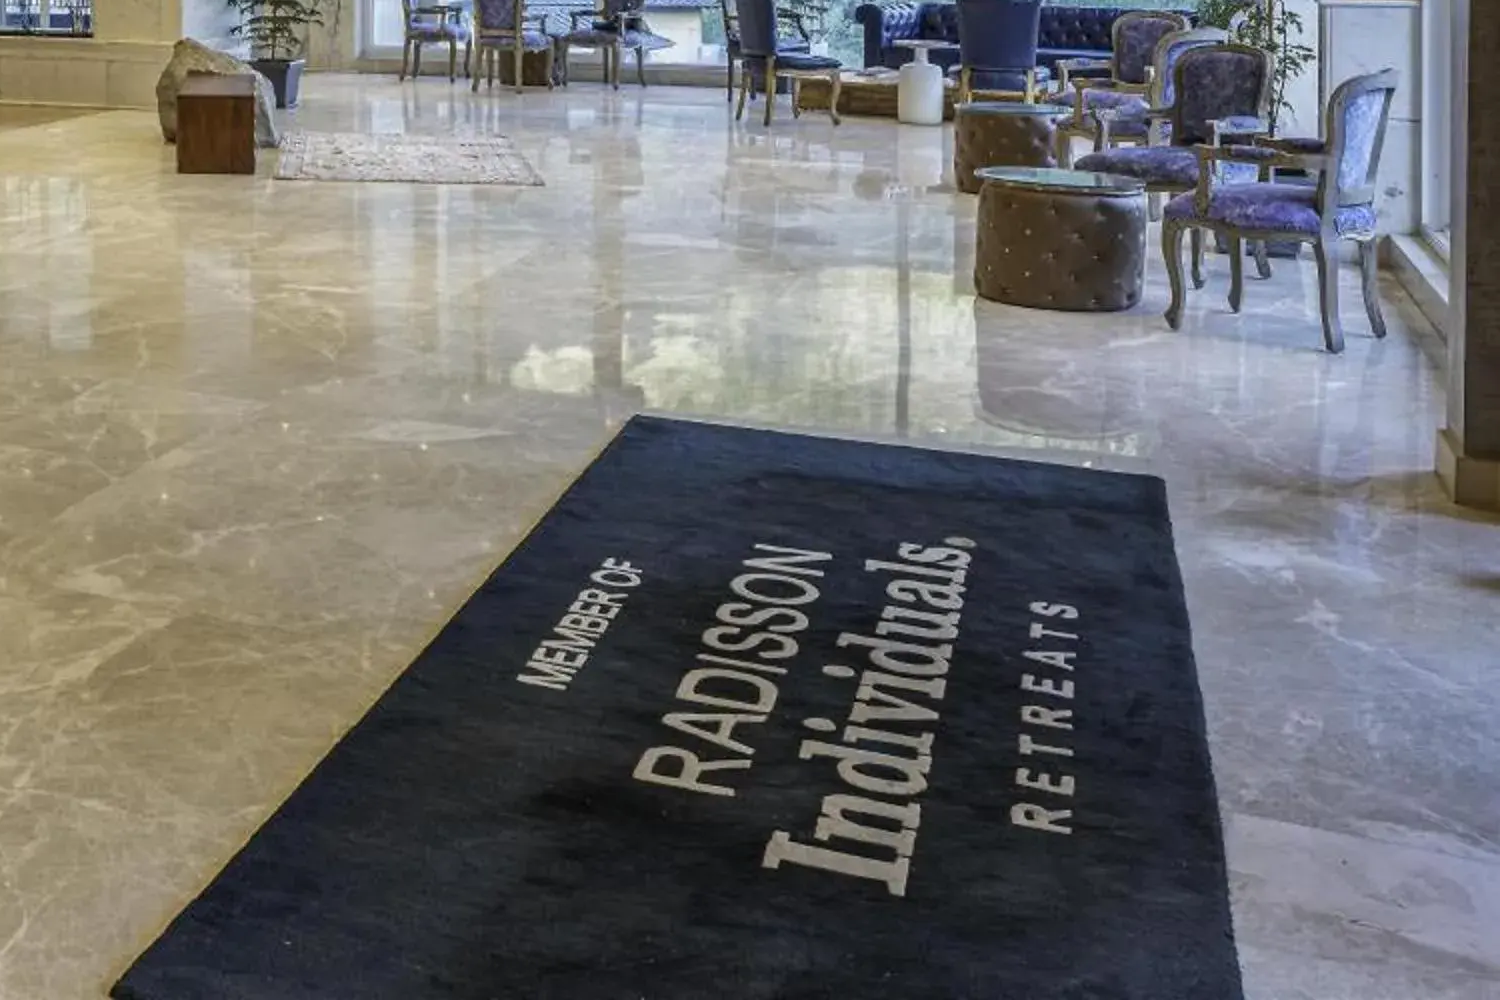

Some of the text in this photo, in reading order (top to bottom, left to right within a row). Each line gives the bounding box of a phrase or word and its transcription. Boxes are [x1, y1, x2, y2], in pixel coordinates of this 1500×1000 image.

[516, 557, 644, 691] MEMBER OF
[632, 543, 833, 797] RADISSON
[762, 536, 977, 897] Individuals.
[1010, 601, 1079, 835] RETREATS
